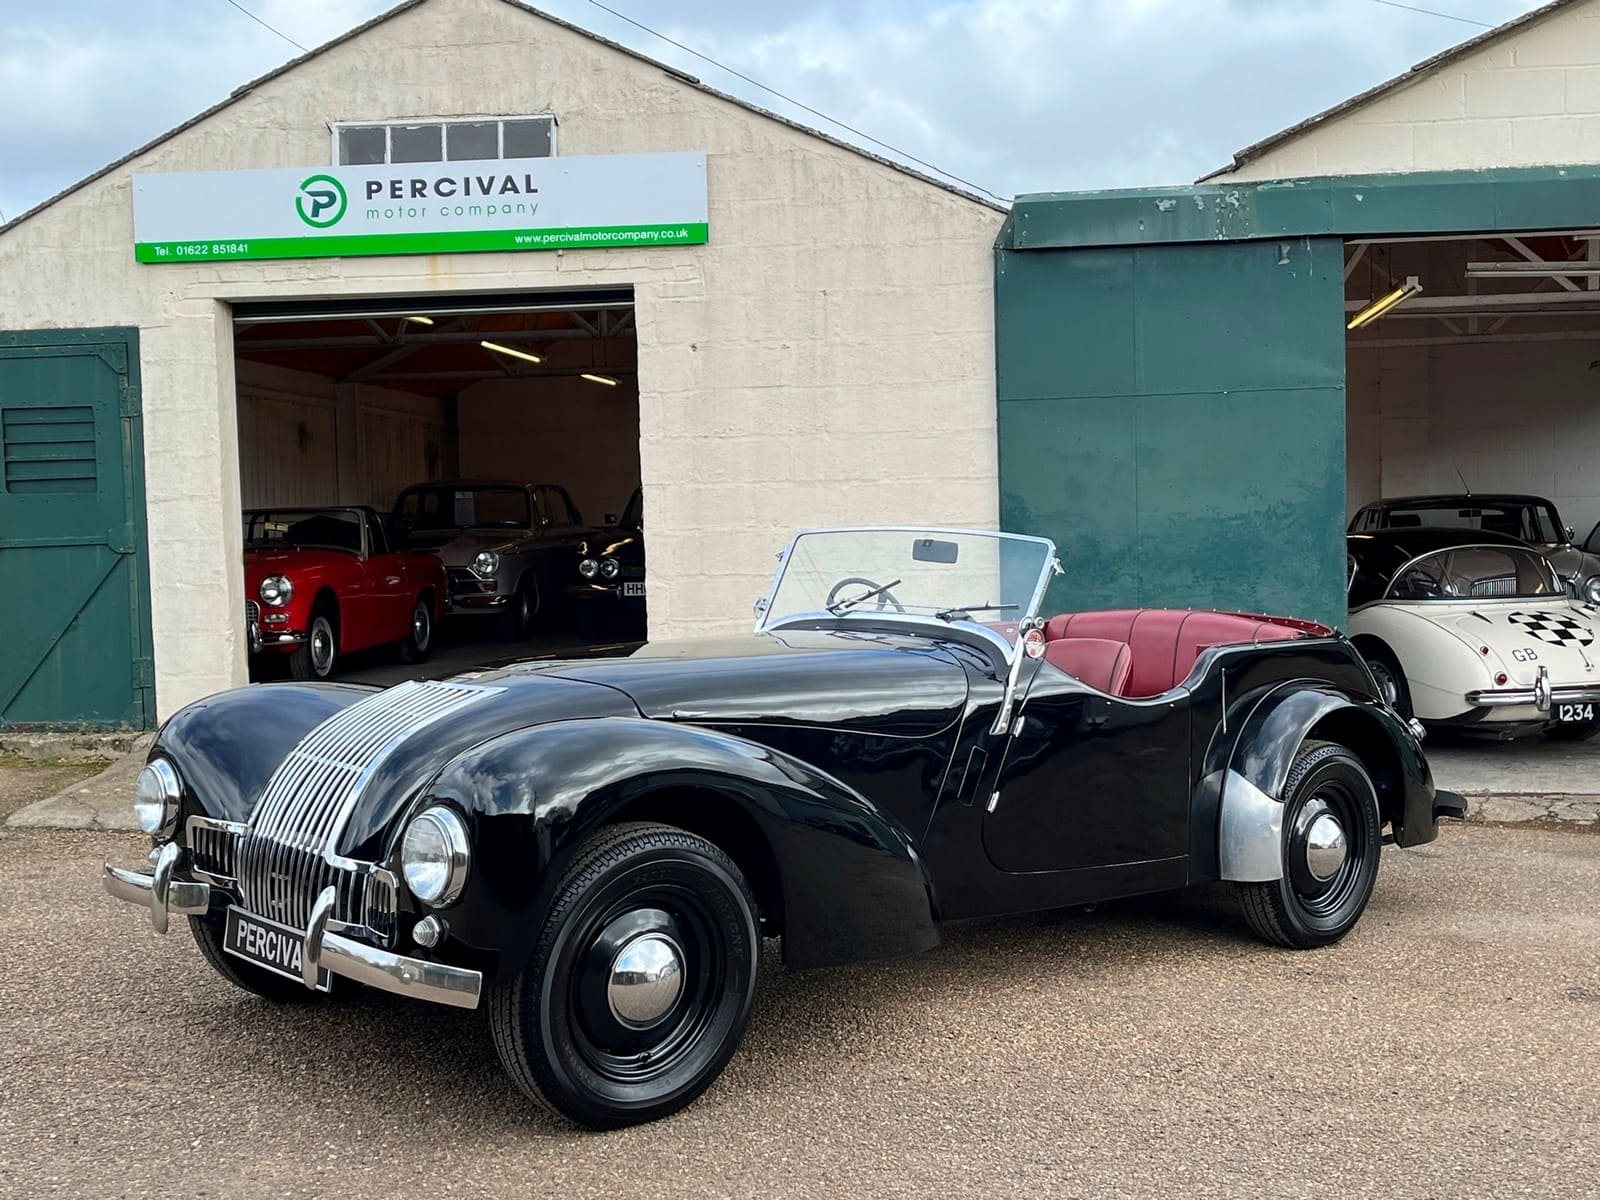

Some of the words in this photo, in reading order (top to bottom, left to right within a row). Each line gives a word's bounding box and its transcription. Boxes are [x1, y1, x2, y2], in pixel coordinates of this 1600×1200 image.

[366, 174, 538, 200] PERCIVAL
[367, 206, 427, 219] motor
[440, 203, 539, 217] company
[515, 228, 689, 244] www.percivalmotorcompany.co.uk
[154, 246, 173, 256] Tel.
[176, 245, 208, 255] 01622
[212, 243, 248, 254] 851841
[626, 583, 645, 595] HH
[1512, 648, 1538, 662] GB
[1559, 703, 1594, 721] 1234
[236, 919, 302, 972] PERCIVA
